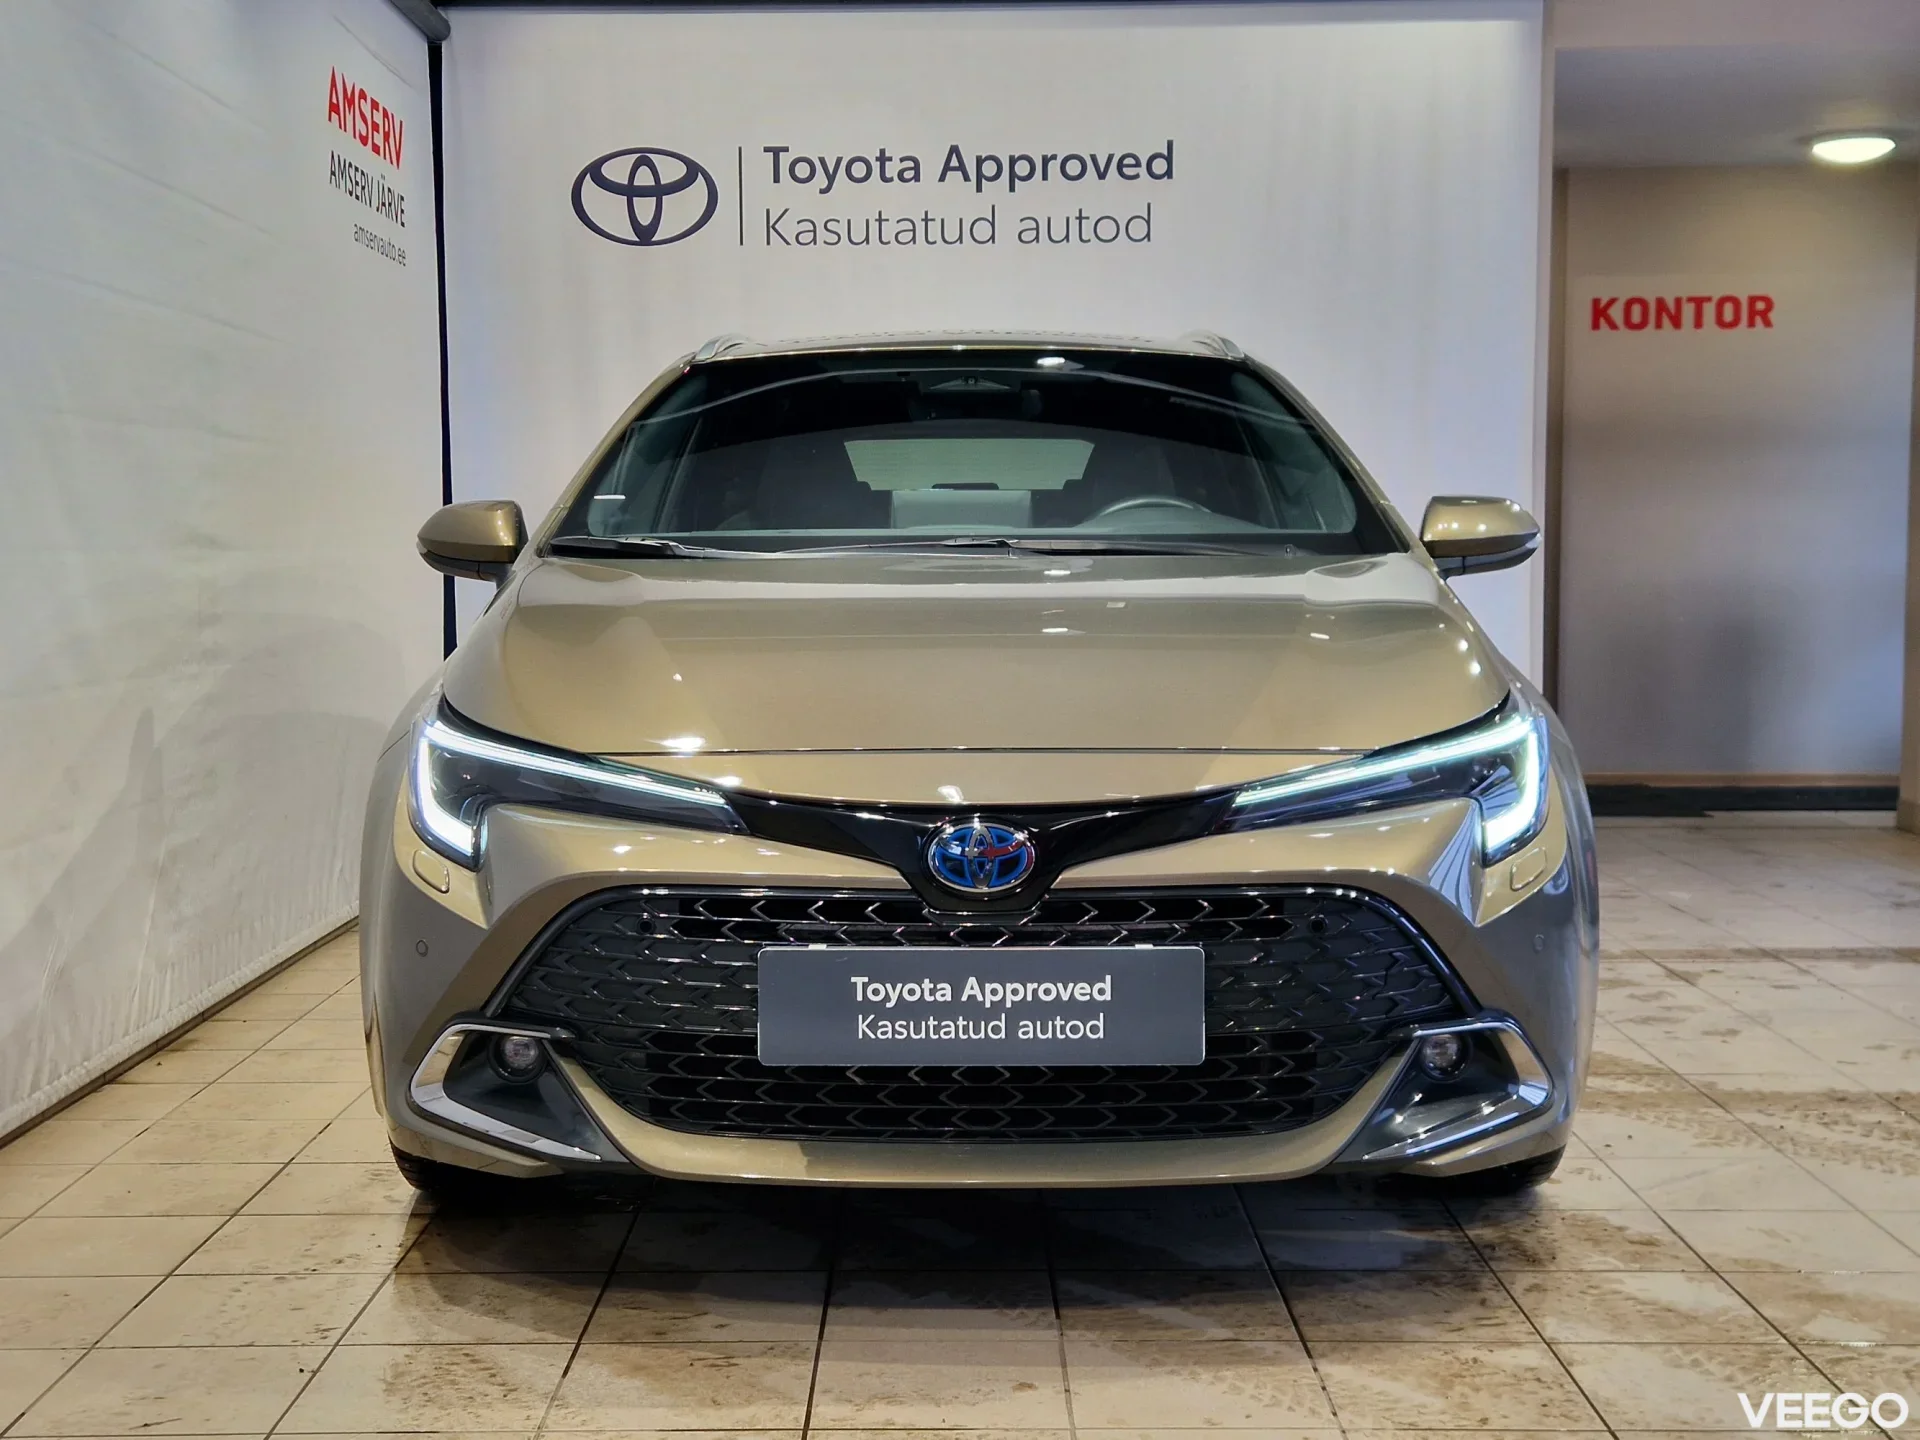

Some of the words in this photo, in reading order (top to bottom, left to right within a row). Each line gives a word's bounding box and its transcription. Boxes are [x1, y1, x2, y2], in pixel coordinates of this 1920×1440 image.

[327, 65, 403, 170] AMSERV
[329, 150, 374, 208] AMSERV
[375, 173, 405, 228] JÄRVE
[763, 145, 922, 194] Toyota
[938, 139, 1174, 193] Approved
[353, 222, 406, 267] amservauto.ee
[764, 203, 997, 247] Kasutatud
[1016, 202, 1153, 245] autod
[1591, 294, 1775, 331] KONTOR
[851, 976, 952, 1008] Toyota
[960, 975, 1112, 1008] Approved
[857, 1013, 1006, 1040] Kasutatud
[1017, 1013, 1104, 1040] autod
